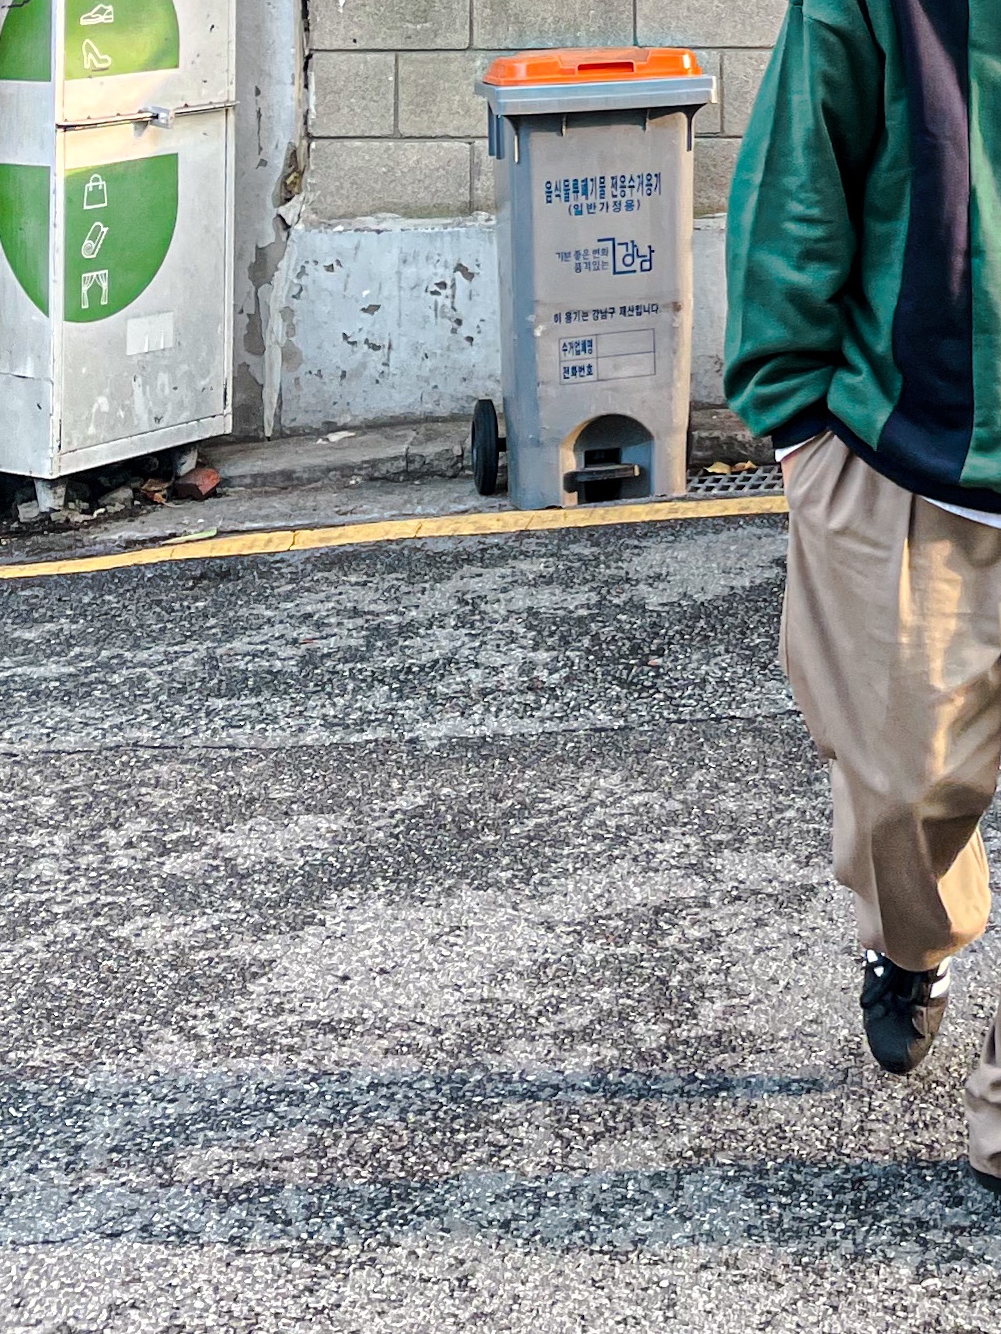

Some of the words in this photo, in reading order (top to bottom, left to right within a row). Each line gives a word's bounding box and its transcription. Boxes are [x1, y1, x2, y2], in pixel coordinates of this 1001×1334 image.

[545, 176, 606, 204] 음식물류폐기물
[610, 172, 662, 198] 전용수거용기
[568, 199, 641, 216] (일반가정용)
[617, 239, 655, 272] 강남
[553, 312, 561, 324] 이
[565, 311, 589, 324] 용기는
[592, 307, 616, 321] 강남구
[563, 364, 593, 379] 전화번호
